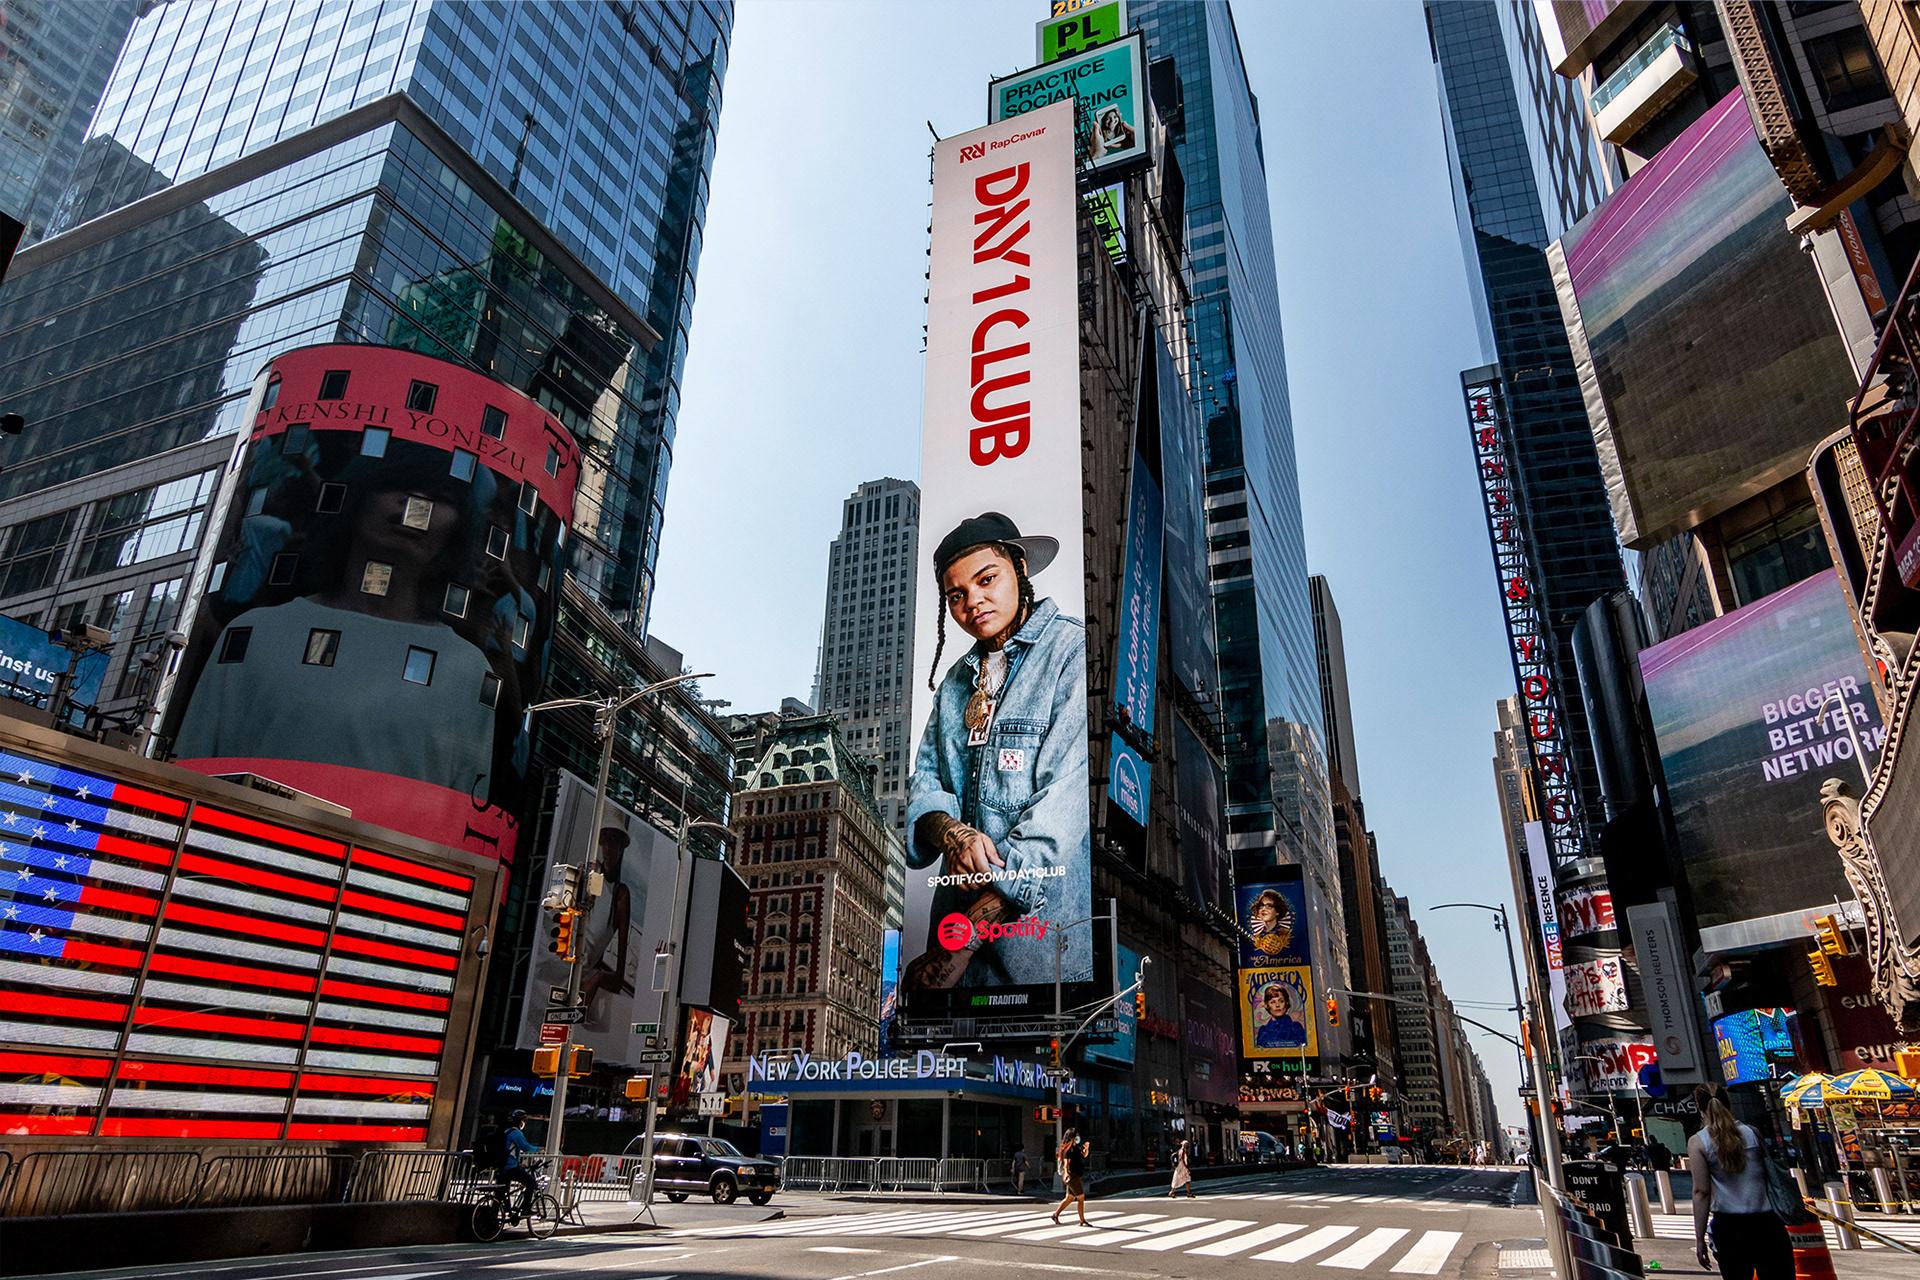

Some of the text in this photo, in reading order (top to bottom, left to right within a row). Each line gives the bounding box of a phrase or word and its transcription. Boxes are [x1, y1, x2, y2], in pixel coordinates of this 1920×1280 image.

[1005, 58, 1105, 103] PRACTICE
[990, 127, 1046, 150] RapCaviar
[277, 402, 389, 424] KENSHI
[408, 411, 527, 474] YONEZU
[1476, 397, 1571, 825] ERNST & YOUNG
[1762, 675, 1860, 725] BIGGER
[1768, 701, 1869, 751] BETTER
[1761, 725, 1888, 782] NETWORK
[927, 865, 1067, 888] SPOTIFY.COM/DAY1CLUB
[976, 915, 1050, 942] Spotify
[1545, 925, 1563, 968] STAGE
[1646, 928, 1673, 1030] THOMSON REUTERS
[748, 1054, 791, 1081] NEW
[794, 1053, 842, 1081] YORK
[846, 1051, 908, 1080] POLICE
[1282, 1060, 1312, 1072] hulu
[1654, 1101, 1698, 1115] CHAS
[1574, 1190, 1587, 1199] BE
